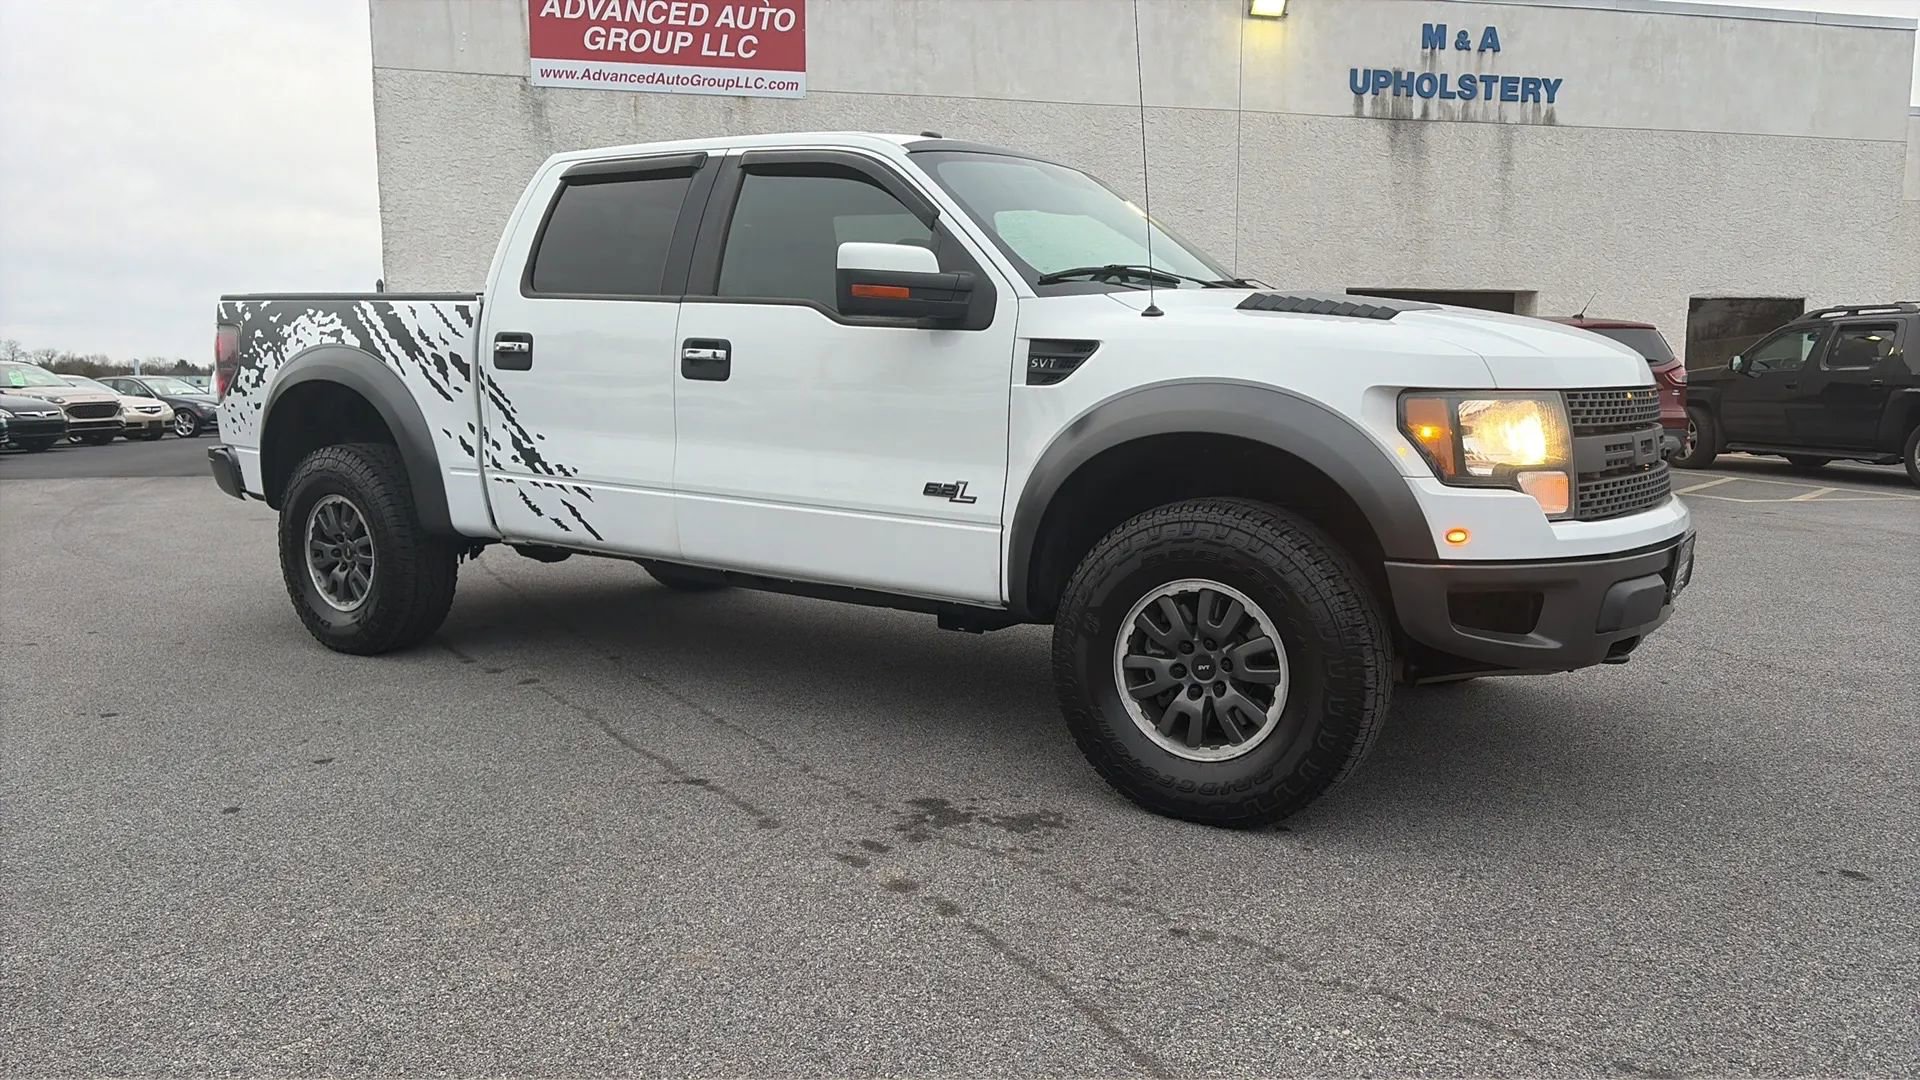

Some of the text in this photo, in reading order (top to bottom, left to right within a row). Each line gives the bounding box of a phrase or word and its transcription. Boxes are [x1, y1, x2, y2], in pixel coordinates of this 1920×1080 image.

[540, 0, 796, 32] ADVANCED AUTO
[583, 26, 759, 58] GROUP LLC
[1422, 23, 1501, 52] M & A
[539, 67, 799, 91] www.AdvancedAutoGroupLLC.com
[1349, 68, 1563, 103] UPHOLSTERY
[1031, 358, 1056, 368] SVT
